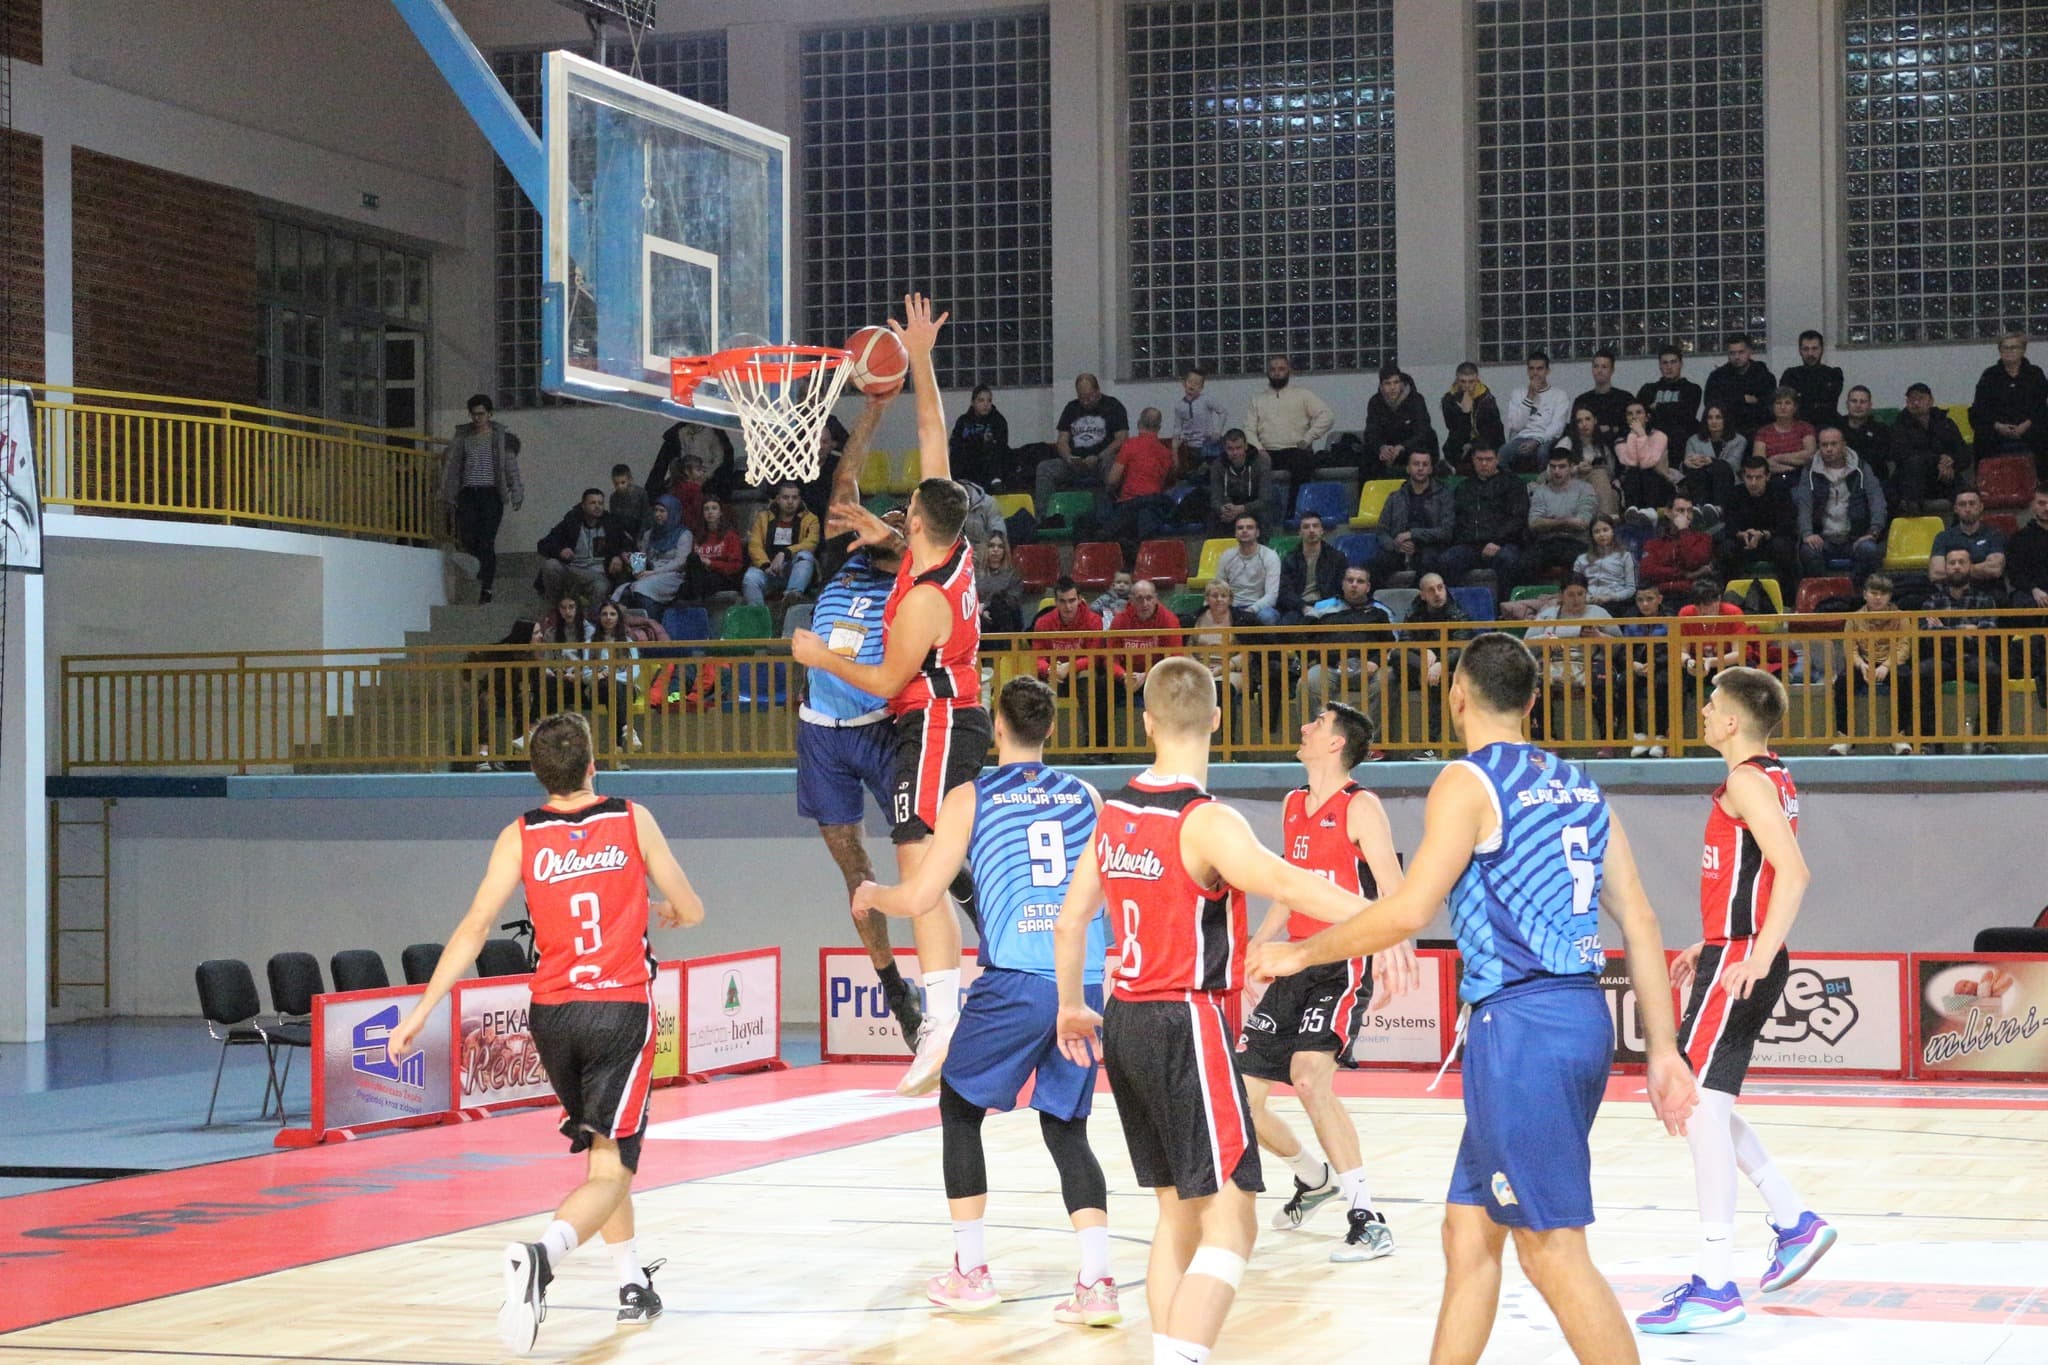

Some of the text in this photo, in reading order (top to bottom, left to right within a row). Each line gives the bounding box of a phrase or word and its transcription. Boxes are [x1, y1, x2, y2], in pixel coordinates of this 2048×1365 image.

[847, 596, 873, 619] 12
[893, 793, 910, 824] 13
[992, 793, 1082, 805] SLAVIJA 1996
[1026, 820, 1067, 887] 9
[1292, 836, 1310, 860] 55
[534, 846, 629, 882] Orlovik
[570, 891, 603, 957] 3
[1120, 899, 1143, 978] 8
[1825, 982, 1847, 994] BH
[1298, 1007, 1325, 1034] 55
[1375, 1015, 1436, 1031] Systems
